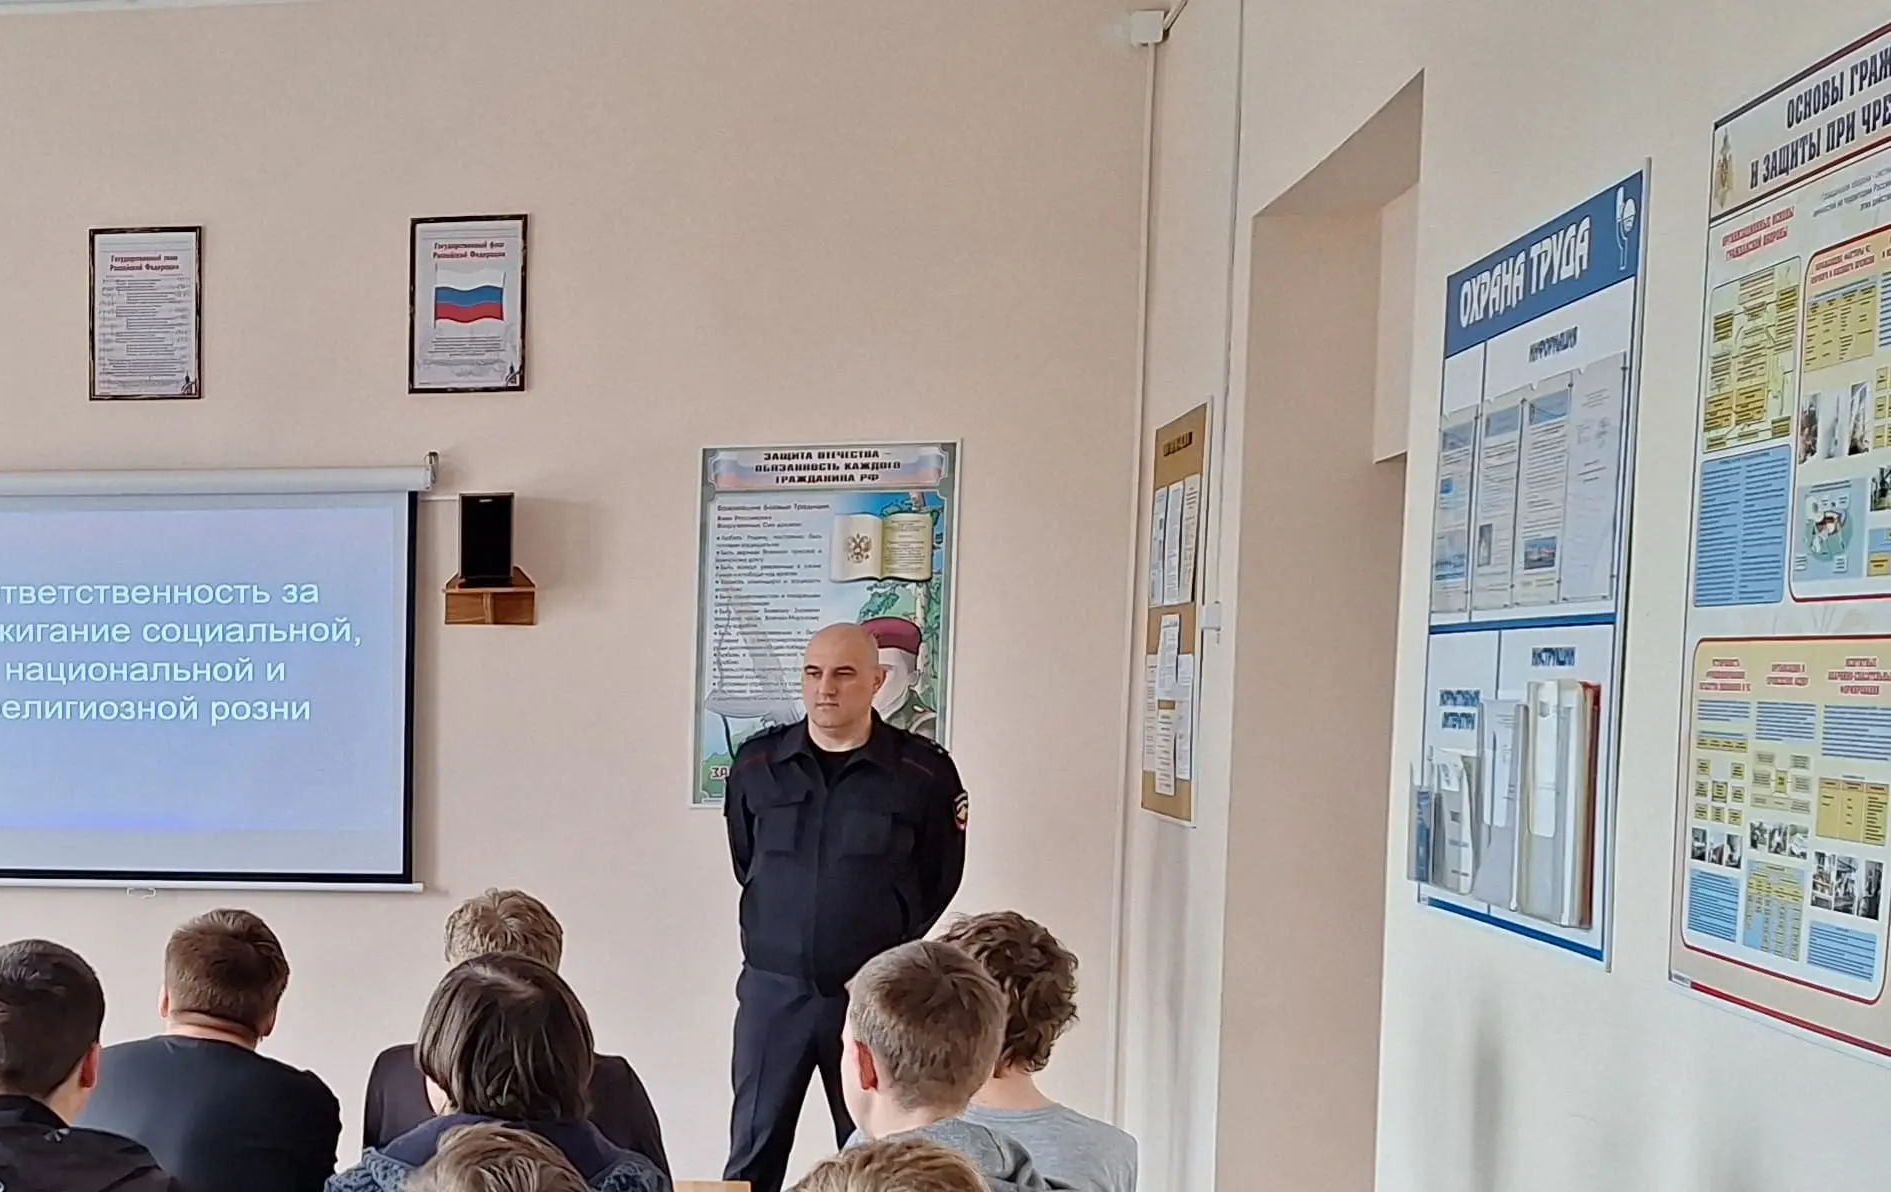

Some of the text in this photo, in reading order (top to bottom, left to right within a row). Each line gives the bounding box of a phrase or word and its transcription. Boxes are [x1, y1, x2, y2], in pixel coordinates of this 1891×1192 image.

[1787, 71, 1844, 129] ОСНОВЫ
[1762, 127, 1821, 183] ЗАЩИТЫ
[1826, 110, 1856, 153] ПРИ
[1459, 215, 1591, 329] ОХРАНА ТРУДА
[755, 461, 901, 472] ОБЯЗАННОСТЬ КАЖДОГО
[763, 452, 813, 461] ЗАЩИТА
[817, 450, 880, 460] ОТЕЧЕСТВА
[775, 474, 879, 484] ГРАЖДАНИНА РФ
[281, 583, 320, 605] за
[142, 617, 363, 649] социальной,
[5, 657, 286, 685] национальной и
[211, 699, 310, 727] розни
